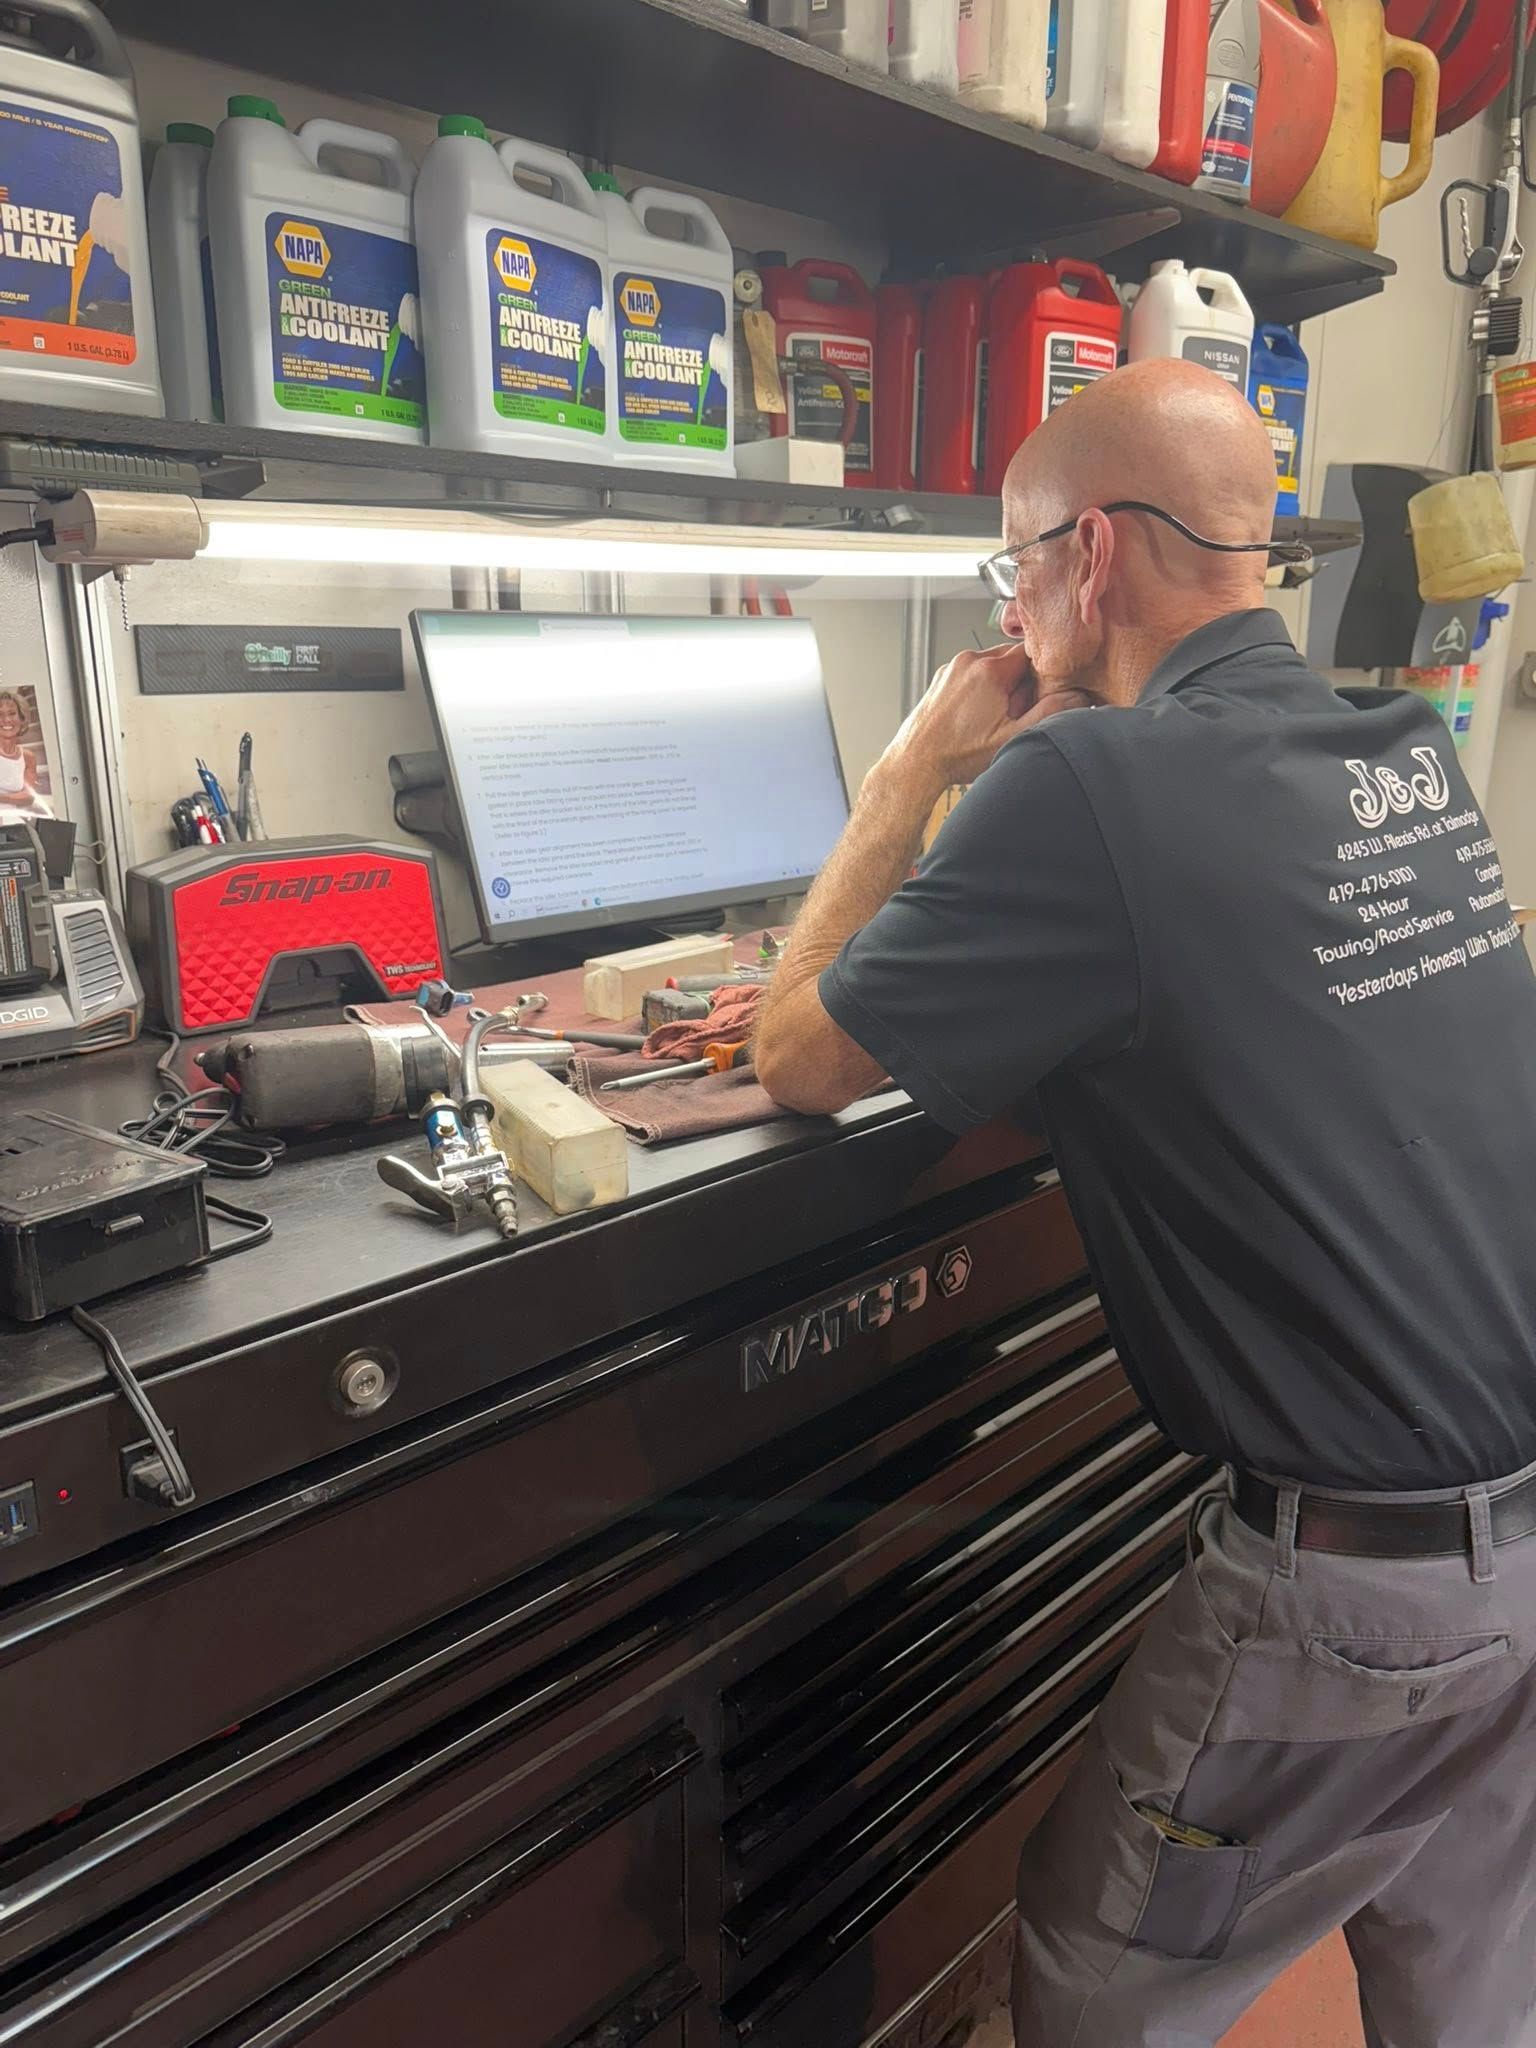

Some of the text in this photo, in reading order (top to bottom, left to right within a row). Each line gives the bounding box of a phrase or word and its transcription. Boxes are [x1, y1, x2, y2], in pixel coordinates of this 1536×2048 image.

[12, 113, 30, 123] MILE
[43, 120, 64, 131] YEAR
[0, 203, 77, 242] REEZE
[0, 231, 78, 268] LANT
[284, 234, 323, 266] NAPA
[501, 250, 530, 280] NAPA
[279, 279, 331, 299] GREEN
[498, 293, 537, 312] GREEN
[627, 290, 655, 315] NAPA
[280, 292, 389, 332] ANTIFREEZE
[500, 305, 581, 343] ANTIFREEZE
[623, 329, 661, 343] GREEN
[624, 341, 703, 368] ANTIFREEZE
[826, 347, 868, 364] Motorcraft
[1079, 347, 1113, 364] Motorcraft
[1204, 350, 1240, 365] NISSAN
[244, 643, 292, 666] O'Reilly
[295, 645, 320, 655] FIRST
[296, 655, 321, 665] CALL
[1344, 746, 1450, 829] J&J
[1337, 809, 1480, 862] 4245 W. Alexis Rd. at Talmadge
[219, 868, 391, 906] Snap-on
[1328, 865, 1418, 904] 419-476-0101
[1358, 896, 1411, 923] 24 Hour
[1415, 908, 1455, 932] Service
[386, 964, 404, 976] TWS
[1420, 945, 1468, 982] Honesty
[1465, 934, 1489, 959] With
[740, 1266, 928, 1393] MATCO
